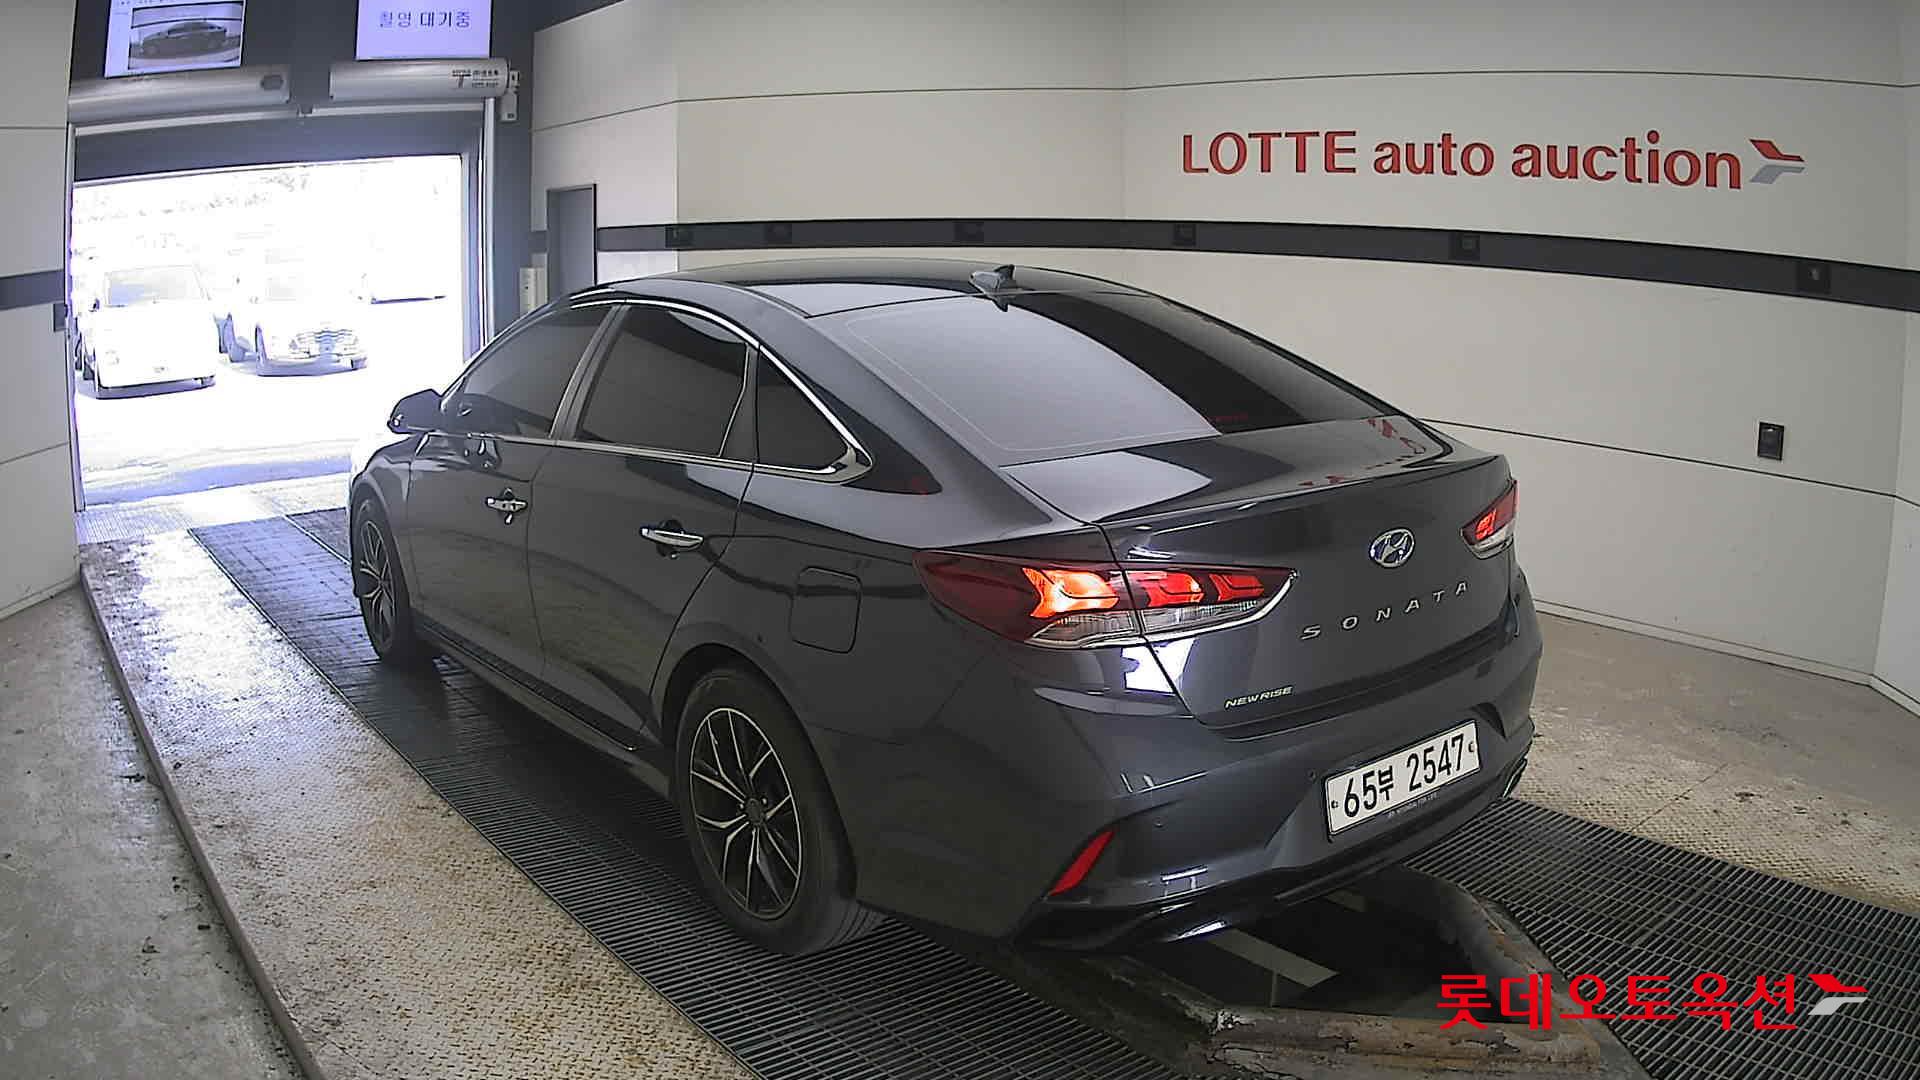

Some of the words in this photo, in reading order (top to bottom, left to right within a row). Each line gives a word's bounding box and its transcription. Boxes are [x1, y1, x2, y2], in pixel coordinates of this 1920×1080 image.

[420, 11, 470, 28] 대기중
[1183, 131, 1357, 175] LOTTE
[1373, 132, 1495, 177] auto
[1510, 129, 1742, 190] auction
[1301, 582, 1468, 640] SONATA
[1344, 766, 1394, 818] 65부
[1406, 734, 1464, 792] 2547
